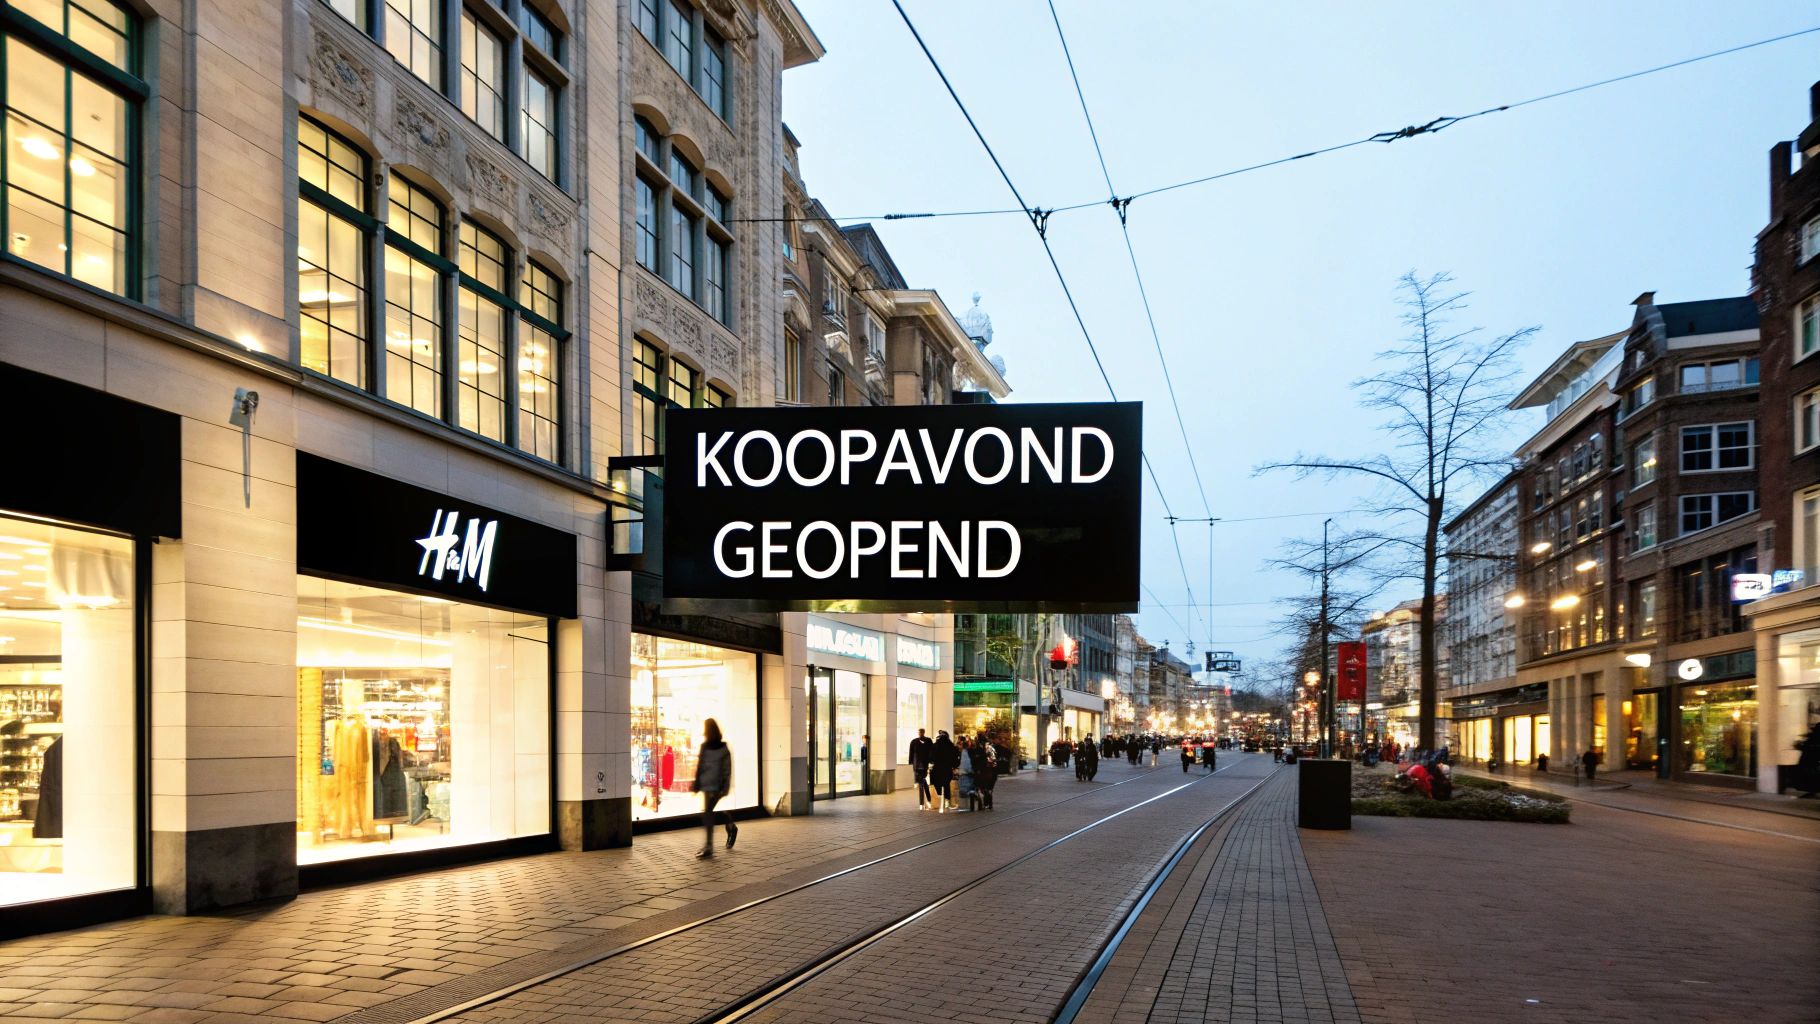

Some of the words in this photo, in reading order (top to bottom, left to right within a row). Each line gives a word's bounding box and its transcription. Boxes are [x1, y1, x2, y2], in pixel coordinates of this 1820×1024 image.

[698, 427, 1114, 487] KOOPAVOND
[415, 509, 498, 592] H&M
[714, 521, 1021, 579] GEOPEND
